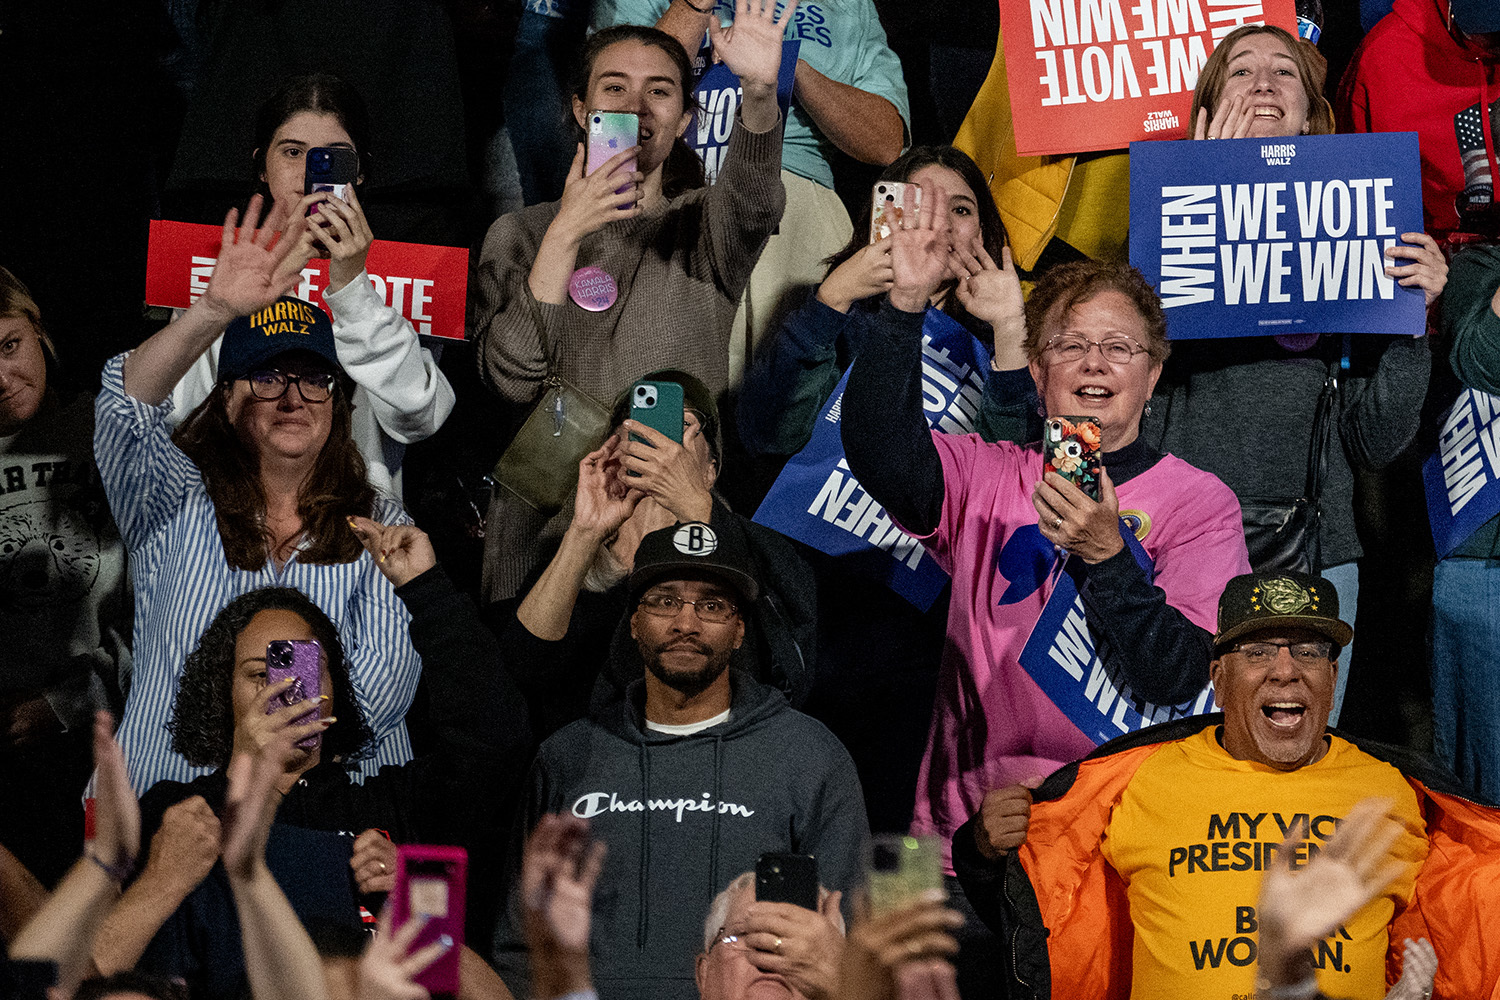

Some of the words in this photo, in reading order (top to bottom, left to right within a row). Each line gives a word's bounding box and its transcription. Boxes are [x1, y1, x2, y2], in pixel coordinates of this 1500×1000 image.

[1035, 43, 1143, 107] VOTE
[1142, 34, 1209, 96] WE
[696, 86, 743, 146] VO
[1143, 115, 1180, 133] HARRIS
[1261, 144, 1296, 158] HARRIS
[1266, 157, 1291, 166] WALZ
[1220, 182, 1287, 241] WE
[1294, 178, 1396, 239] VOTE
[1160, 184, 1217, 309] WHEN
[575, 274, 612, 289] KAMALA
[577, 282, 616, 299] HARRIS
[1220, 242, 1293, 306] WE
[1299, 238, 1396, 302] WIN
[251, 300, 316, 329] HARRIS
[368, 273, 435, 322] OTE
[262, 323, 310, 337] WALZ
[1438, 387, 1488, 517] WHEN
[688, 525, 704, 552] B
[807, 469, 926, 571] WHEN
[1048, 593, 1095, 683] WH
[571, 792, 755, 823] Champion
[1207, 812, 1268, 840] MY
[1169, 841, 1324, 878] PRESIDE
[1189, 936, 1352, 974] WON.
